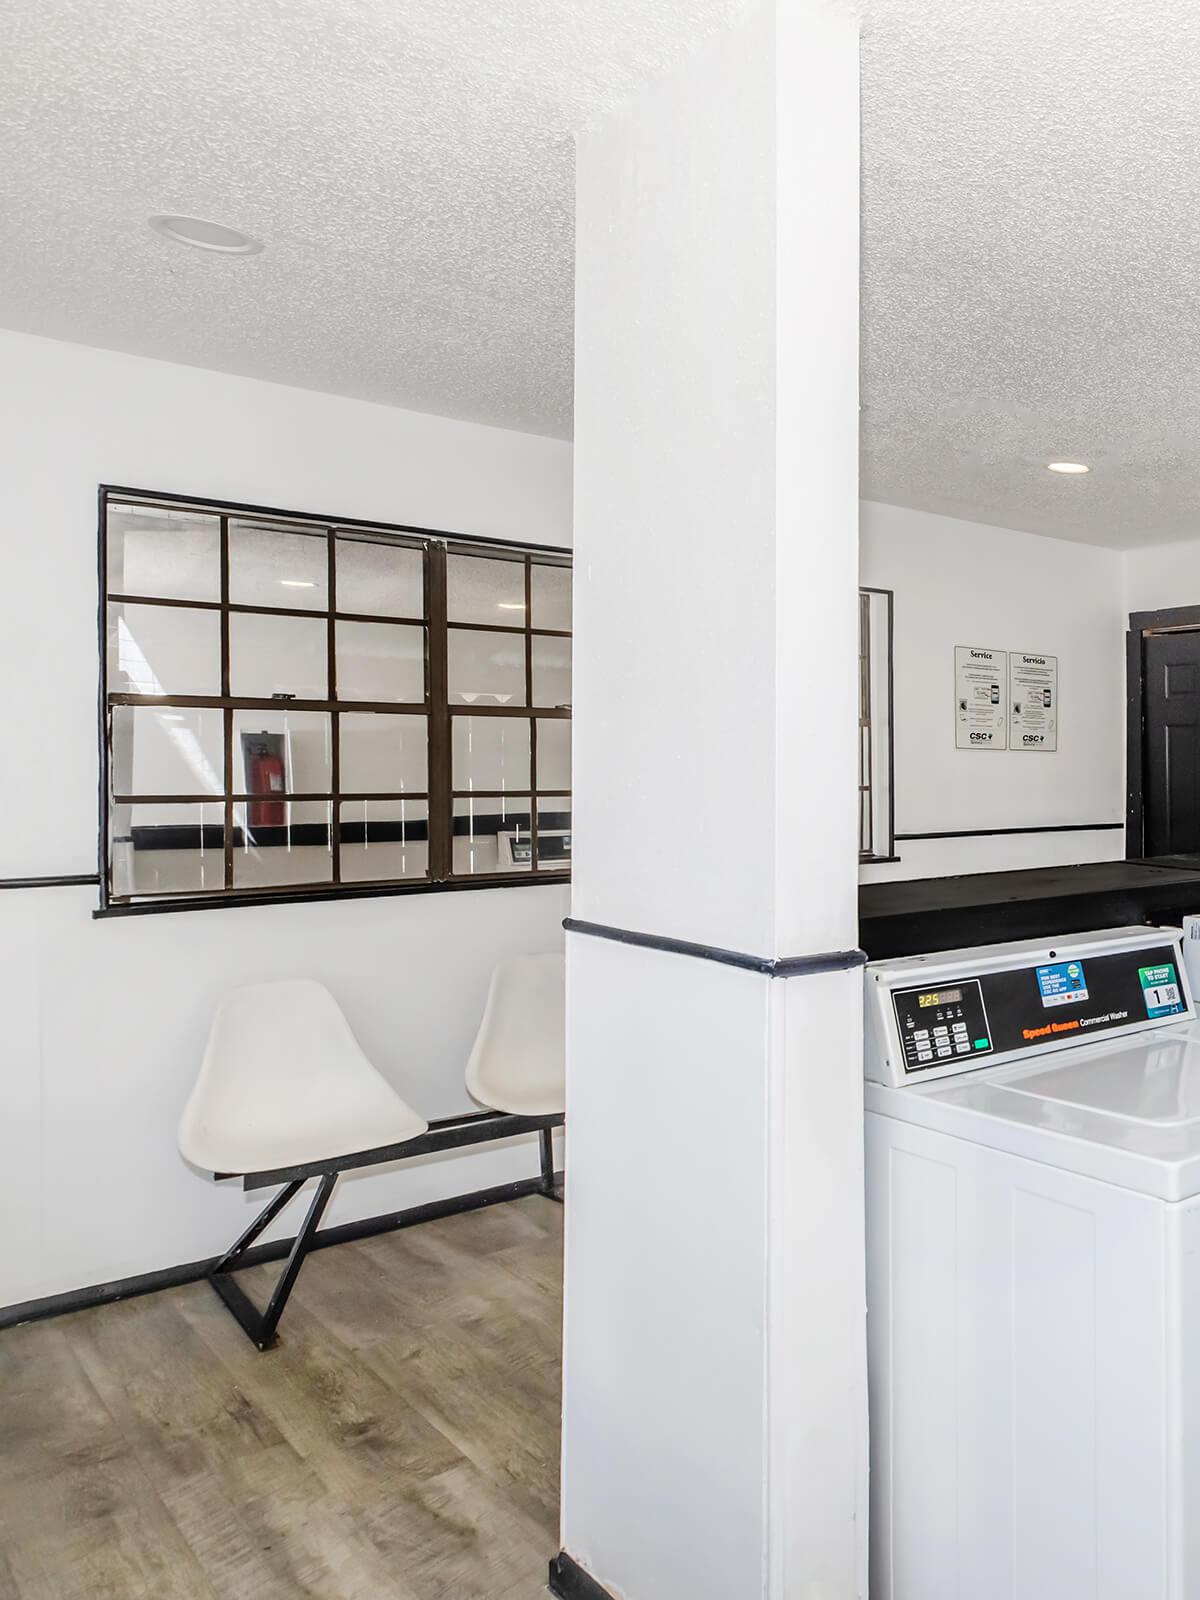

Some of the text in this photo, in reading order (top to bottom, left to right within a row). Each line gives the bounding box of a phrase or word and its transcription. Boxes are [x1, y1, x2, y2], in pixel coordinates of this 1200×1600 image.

[970, 649, 993, 660] Service
[1022, 655, 1046, 665] Servicio
[969, 732, 988, 740] CSC
[1022, 734, 1040, 742] CSC
[1153, 989, 1161, 1004] 1
[1023, 1010, 1128, 1040] Speed Queen Commercial Washer
